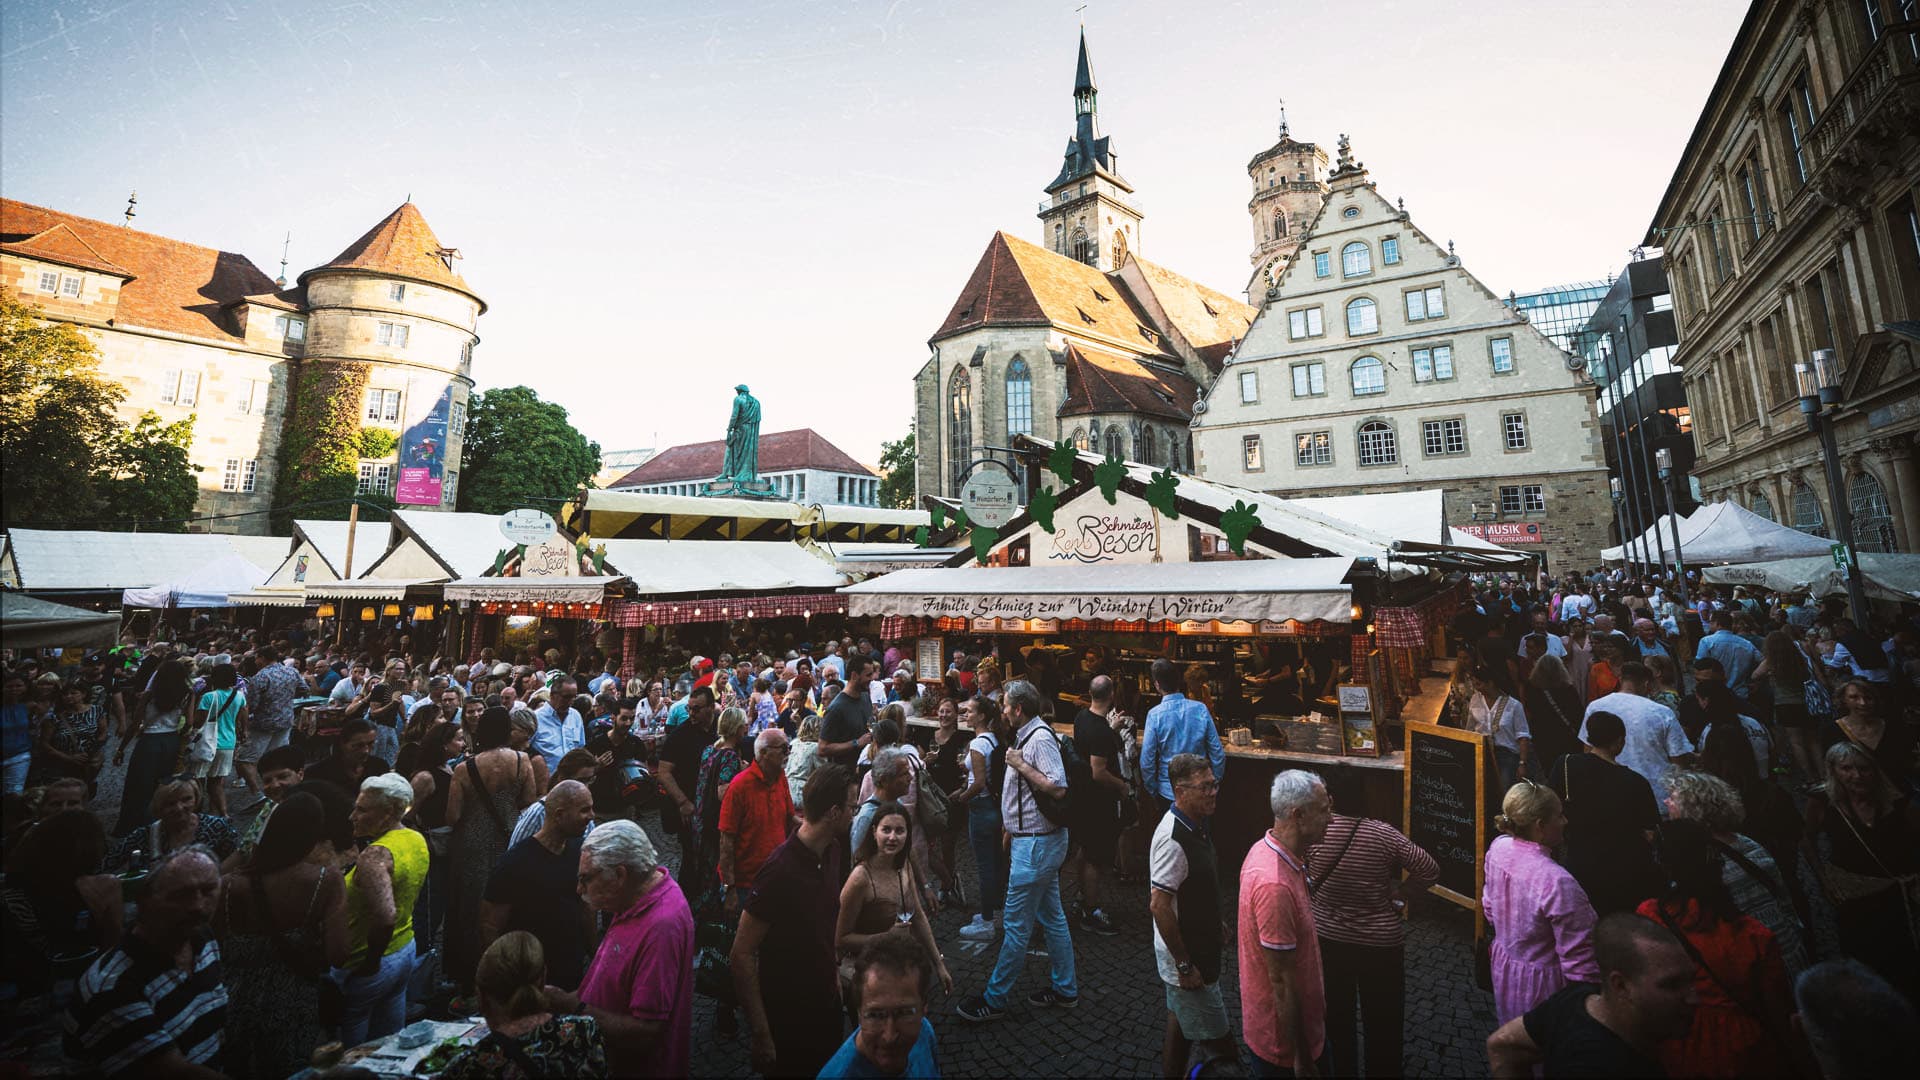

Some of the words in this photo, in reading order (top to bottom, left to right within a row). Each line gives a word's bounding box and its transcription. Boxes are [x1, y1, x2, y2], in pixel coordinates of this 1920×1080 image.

[1098, 517, 1154, 534] Schmiegs
[1461, 526, 1482, 536] DER
[1485, 524, 1521, 536] MUSIK
[1075, 515, 1157, 559] Besen
[922, 597, 970, 613] Familie
[970, 597, 1034, 619] Schmieg
[1038, 601, 1064, 613] zur
[1070, 597, 1155, 620] "Weindorf
[1161, 597, 1233, 618] Wirtin"
